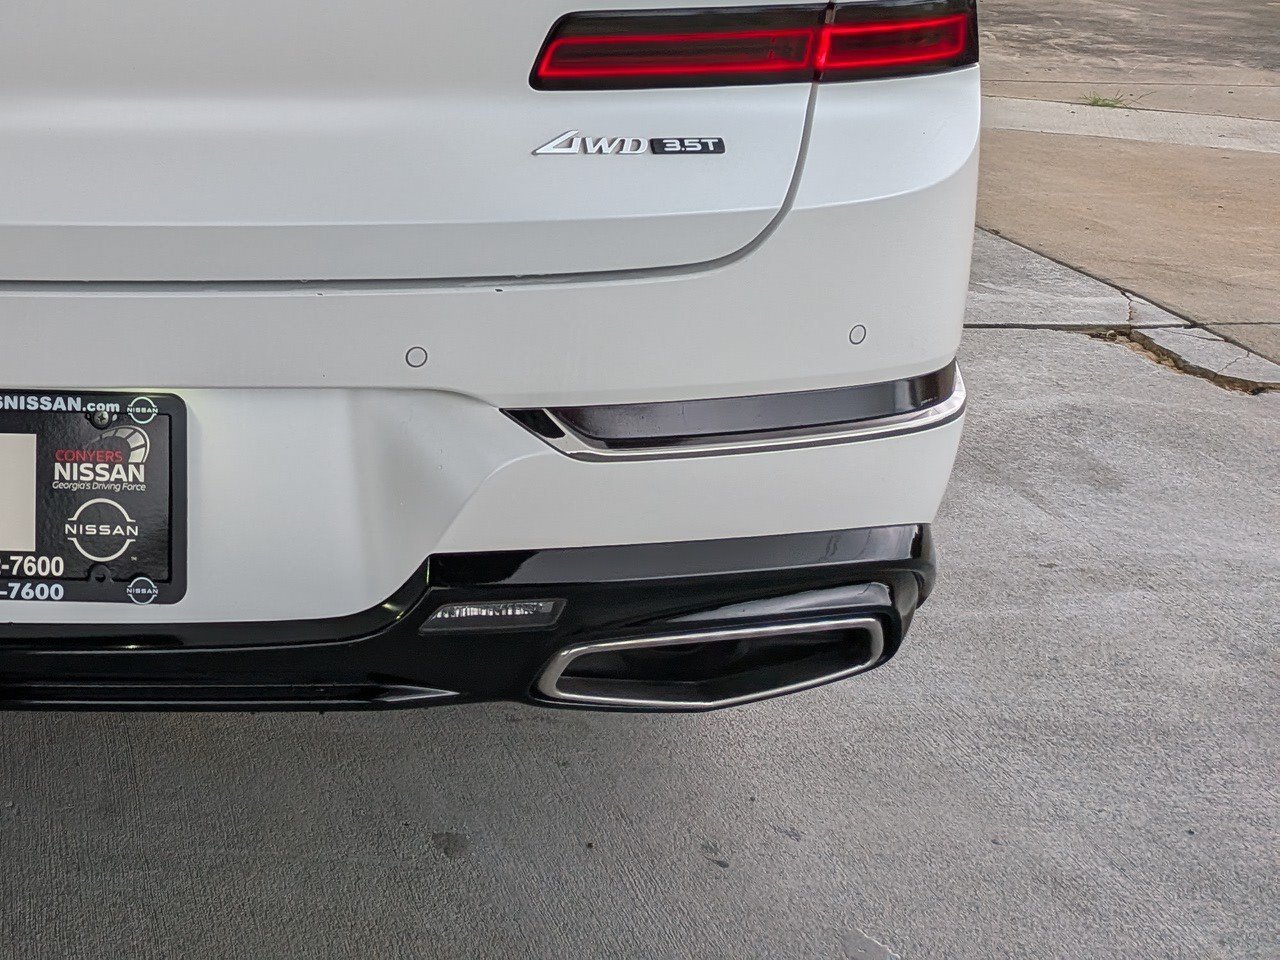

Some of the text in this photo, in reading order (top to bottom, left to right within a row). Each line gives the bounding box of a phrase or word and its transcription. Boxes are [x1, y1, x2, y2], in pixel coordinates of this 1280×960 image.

[531, 129, 719, 155] 4WD 3.5T
[126, 406, 159, 414] NISSAN
[55, 449, 123, 462] CONYERS
[54, 462, 145, 482] NISSAN
[52, 481, 147, 492] Georgia's Driving Force
[65, 524, 139, 536] NISSAN
[126, 587, 159, 595] NISSAN
